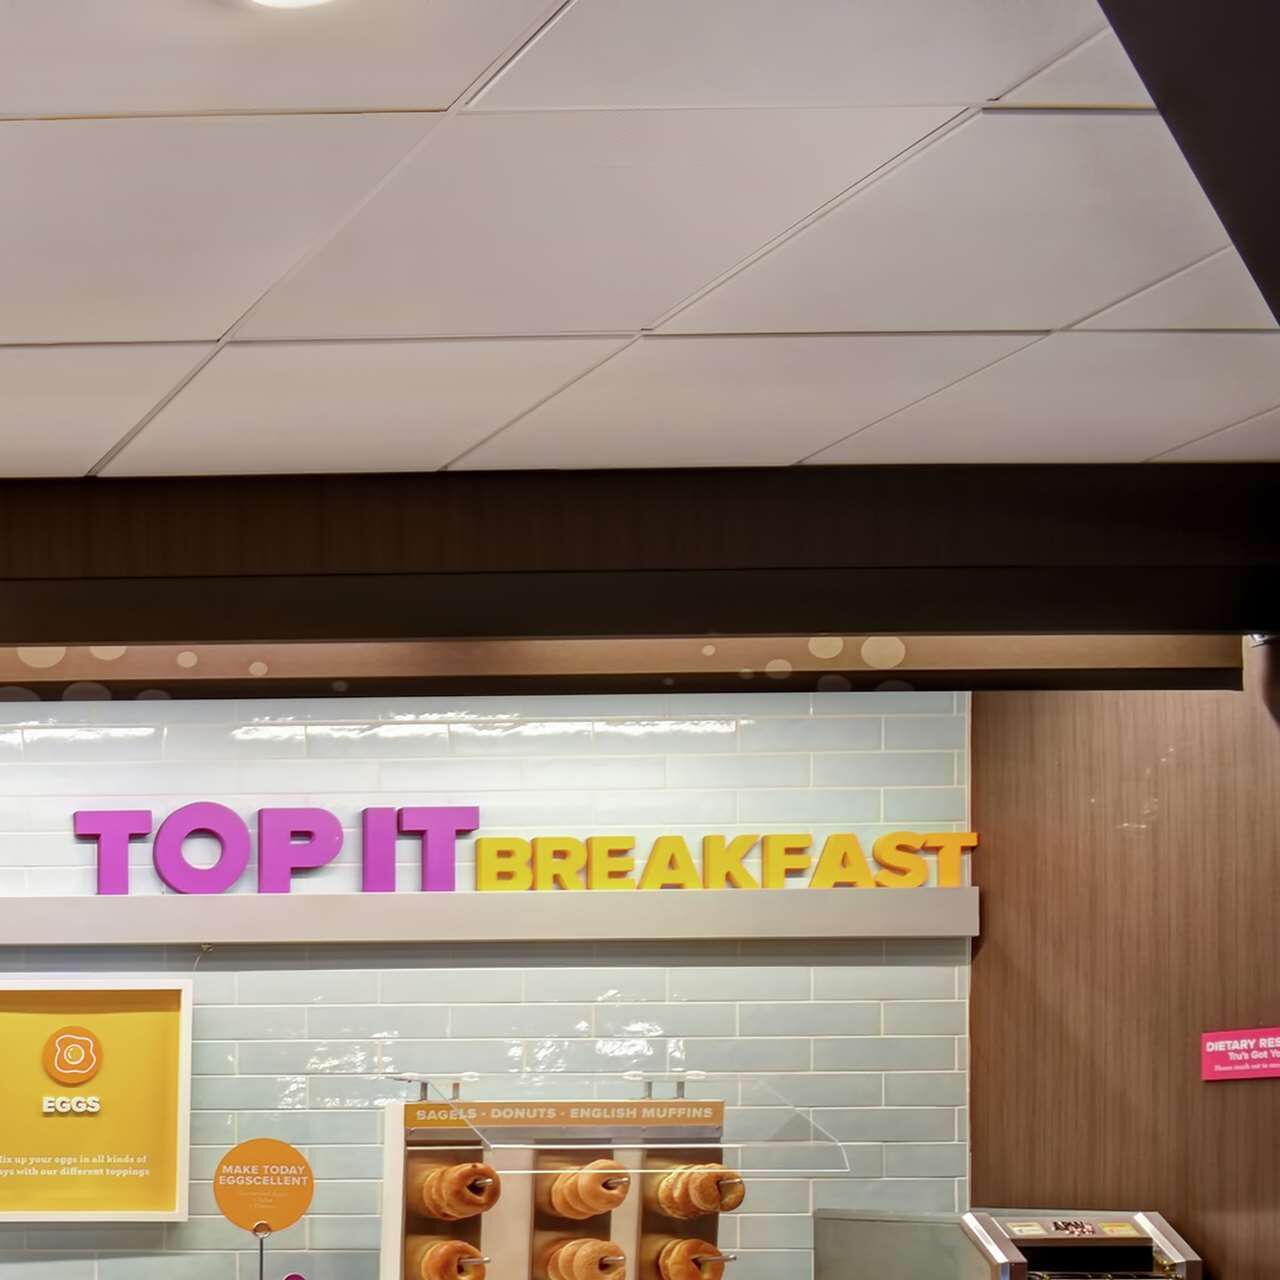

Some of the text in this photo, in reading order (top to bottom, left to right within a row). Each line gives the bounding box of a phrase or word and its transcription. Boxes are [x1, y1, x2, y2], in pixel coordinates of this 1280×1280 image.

[73, 801, 480, 894] TOP IT
[475, 831, 978, 891] BREAKFAST
[1206, 1039, 1257, 1053] DIETARY
[1228, 1050, 1250, 1061] Tru's
[1251, 1050, 1268, 1060] Got
[42, 1096, 101, 1112] EGGS
[416, 1107, 713, 1120] BAGELS DONUTS ENGLISH MUFFINS
[15, 1157, 27, 1166] up
[28, 1157, 52, 1167] your
[54, 1157, 77, 1166] eggs
[80, 1156, 89, 1164] in
[92, 1155, 105, 1164] all
[107, 1155, 134, 1164] kinds
[136, 1155, 147, 1164] of
[16, 1168, 38, 1176] with
[59, 1167, 104, 1176] different
[106, 1168, 149, 1178] toppings
[222, 1165, 305, 1174] MAKE TODAY
[219, 1175, 308, 1185] EGGSCELLENT
